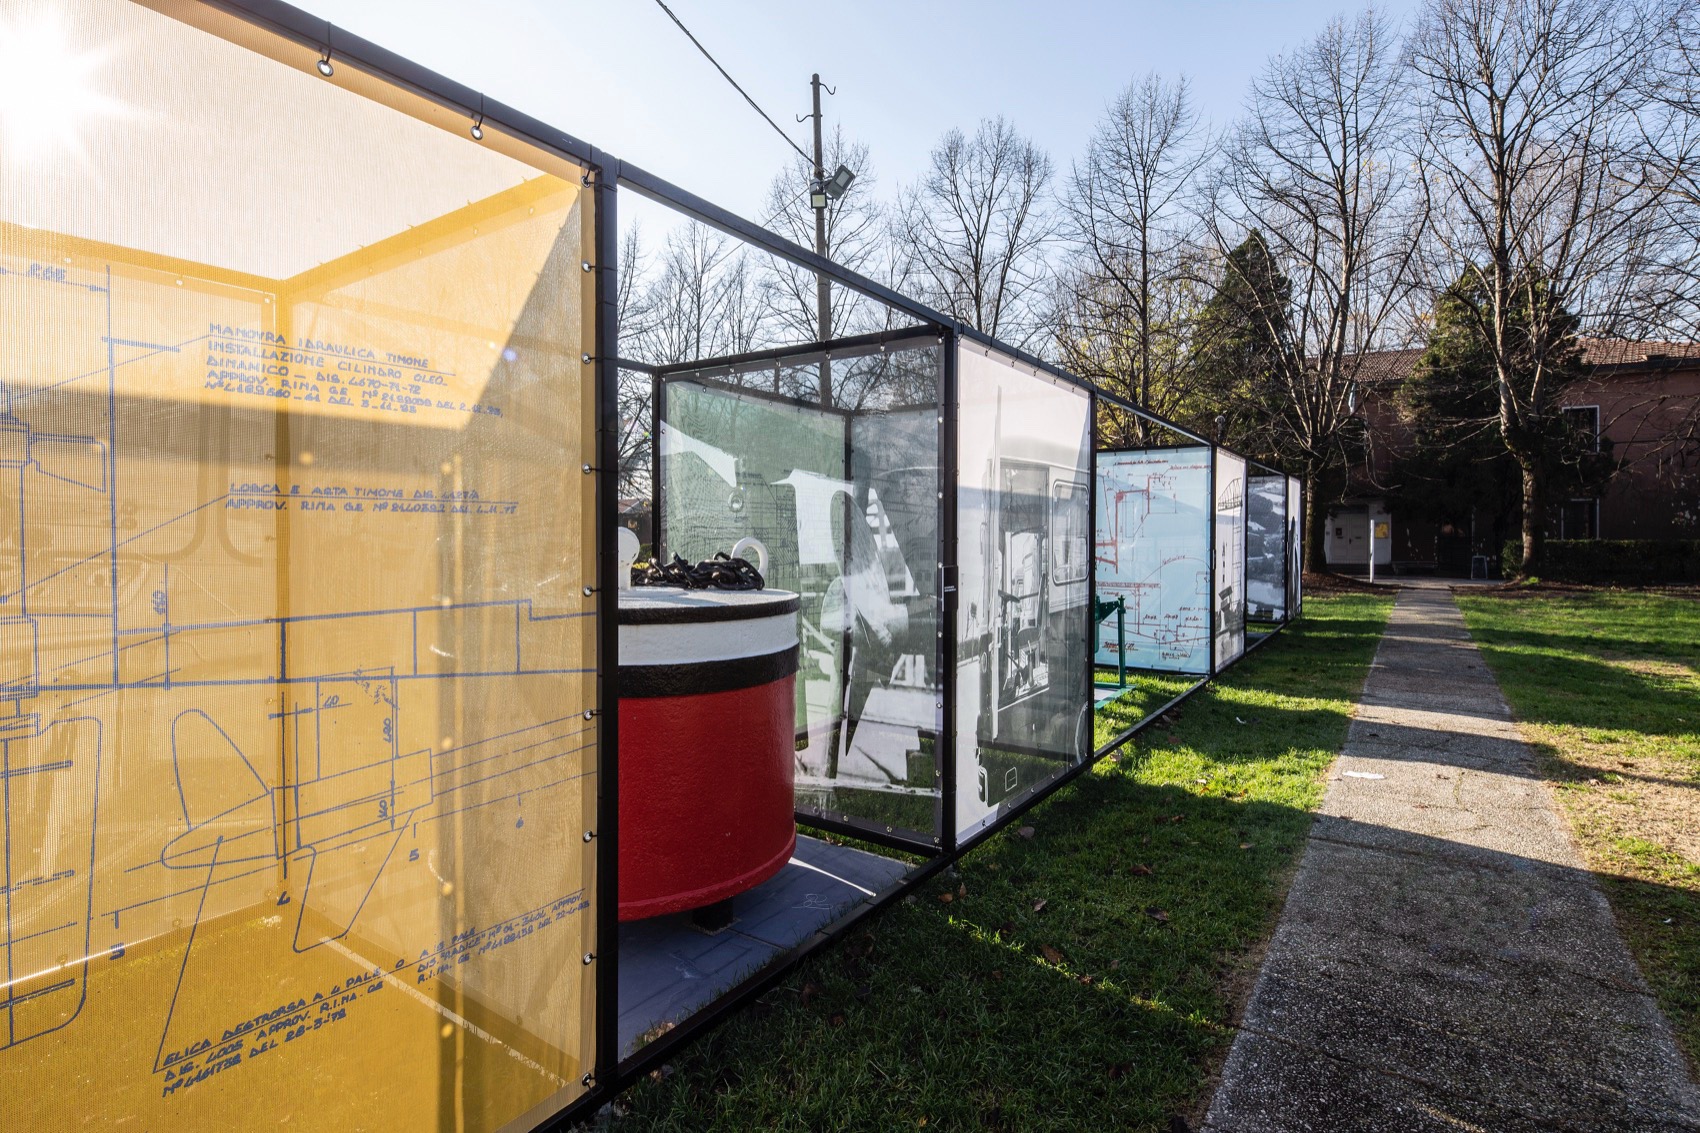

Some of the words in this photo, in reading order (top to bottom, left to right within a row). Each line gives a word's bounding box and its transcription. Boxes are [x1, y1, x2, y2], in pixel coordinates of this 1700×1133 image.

[209, 322, 287, 345] MANOVRA
[298, 337, 375, 359] IDRAULICA
[386, 352, 429, 369] TIMONE
[206, 355, 289, 377] DINAMICO
[316, 371, 345, 385] DIS.
[207, 340, 325, 368] INSTALLAZIONE
[337, 360, 402, 379] CILINDRO
[206, 369, 270, 387] APPROV.
[281, 379, 319, 392] RINA
[329, 386, 349, 395] GE
[328, 395, 354, 407] DEL
[225, 498, 287, 510] APPROV.
[300, 500, 335, 511] RINA
[354, 487, 403, 498] TIMONE
[409, 848, 420, 862] 5
[163, 1038, 212, 1067] ELICA
[221, 998, 307, 1042] DESTRORSA
[313, 992, 324, 1003] A
[345, 966, 382, 988] PALE
[451, 926, 475, 945] PALE
[163, 1060, 200, 1083] DIS.
[256, 1011, 311, 1042] APPROV.
[367, 980, 384, 994] GE
[248, 1039, 279, 1058] DEL
